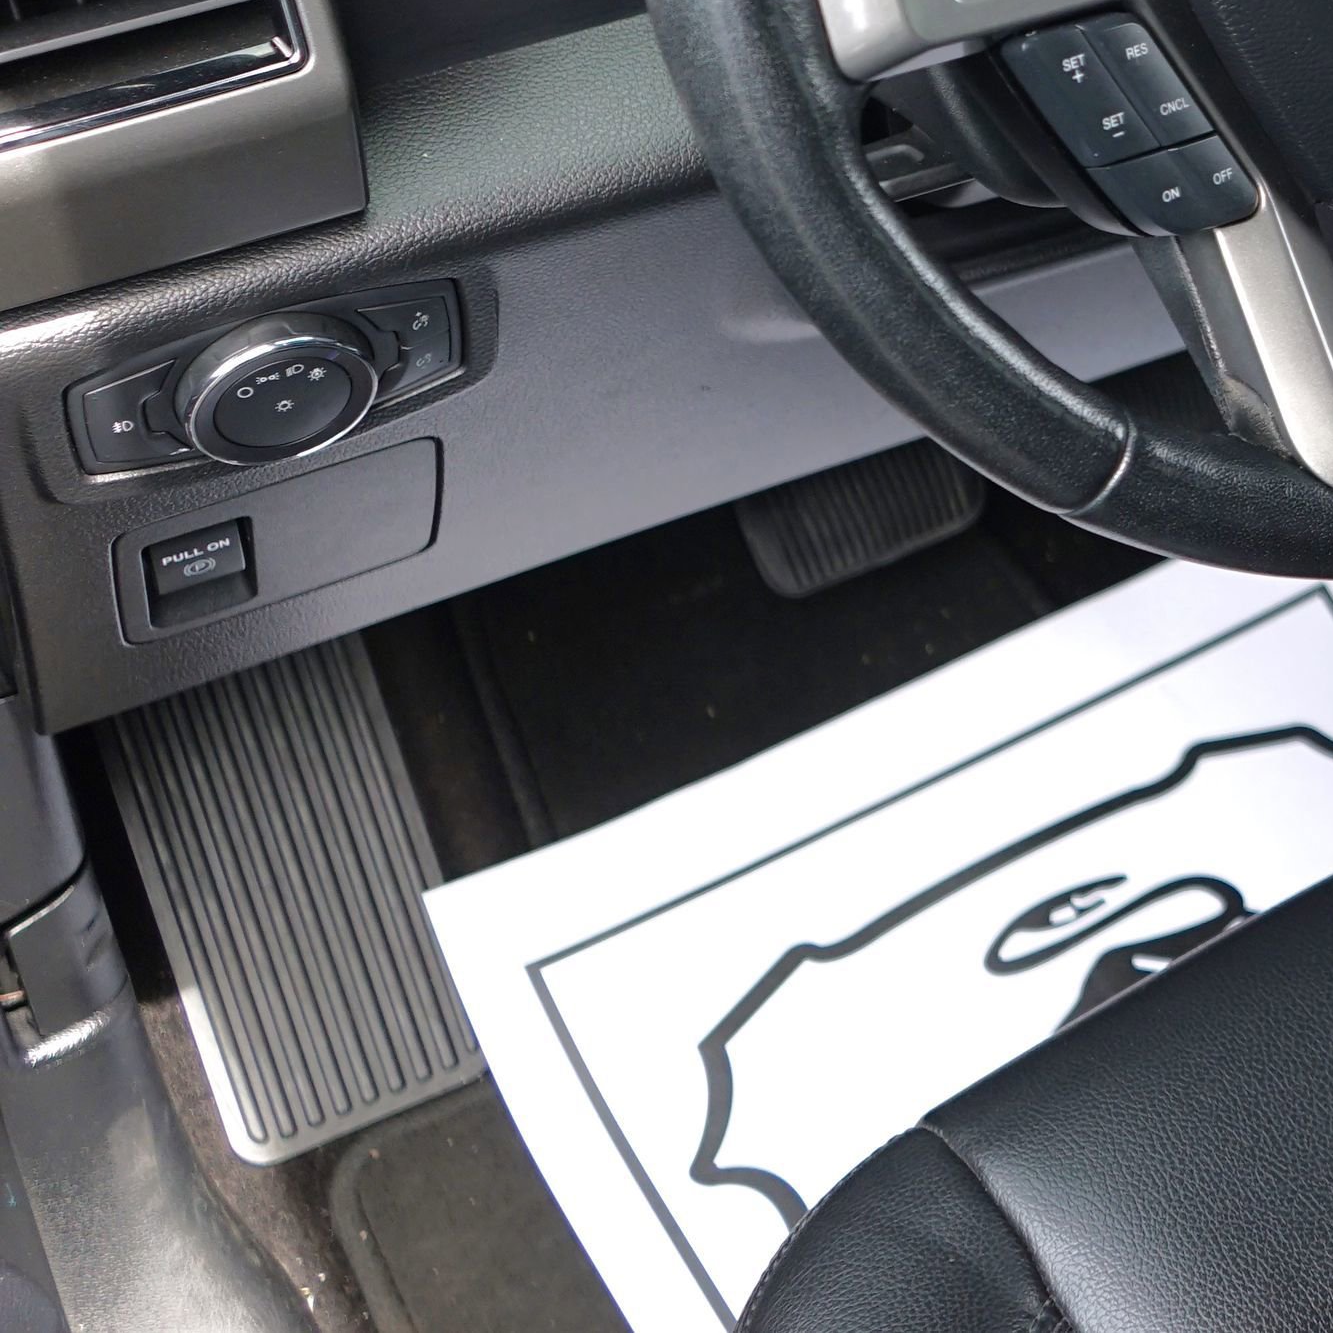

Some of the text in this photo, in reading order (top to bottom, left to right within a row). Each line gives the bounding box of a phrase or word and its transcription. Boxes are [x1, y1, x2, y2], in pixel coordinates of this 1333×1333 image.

[1124, 42, 1149, 61] RES
[1061, 53, 1086, 72] SET
[1159, 97, 1190, 117] CNCL
[1102, 112, 1125, 131] SET
[1212, 166, 1234, 186] OFF
[1161, 185, 1182, 203] ON
[162, 537, 230, 566] PULL ON
